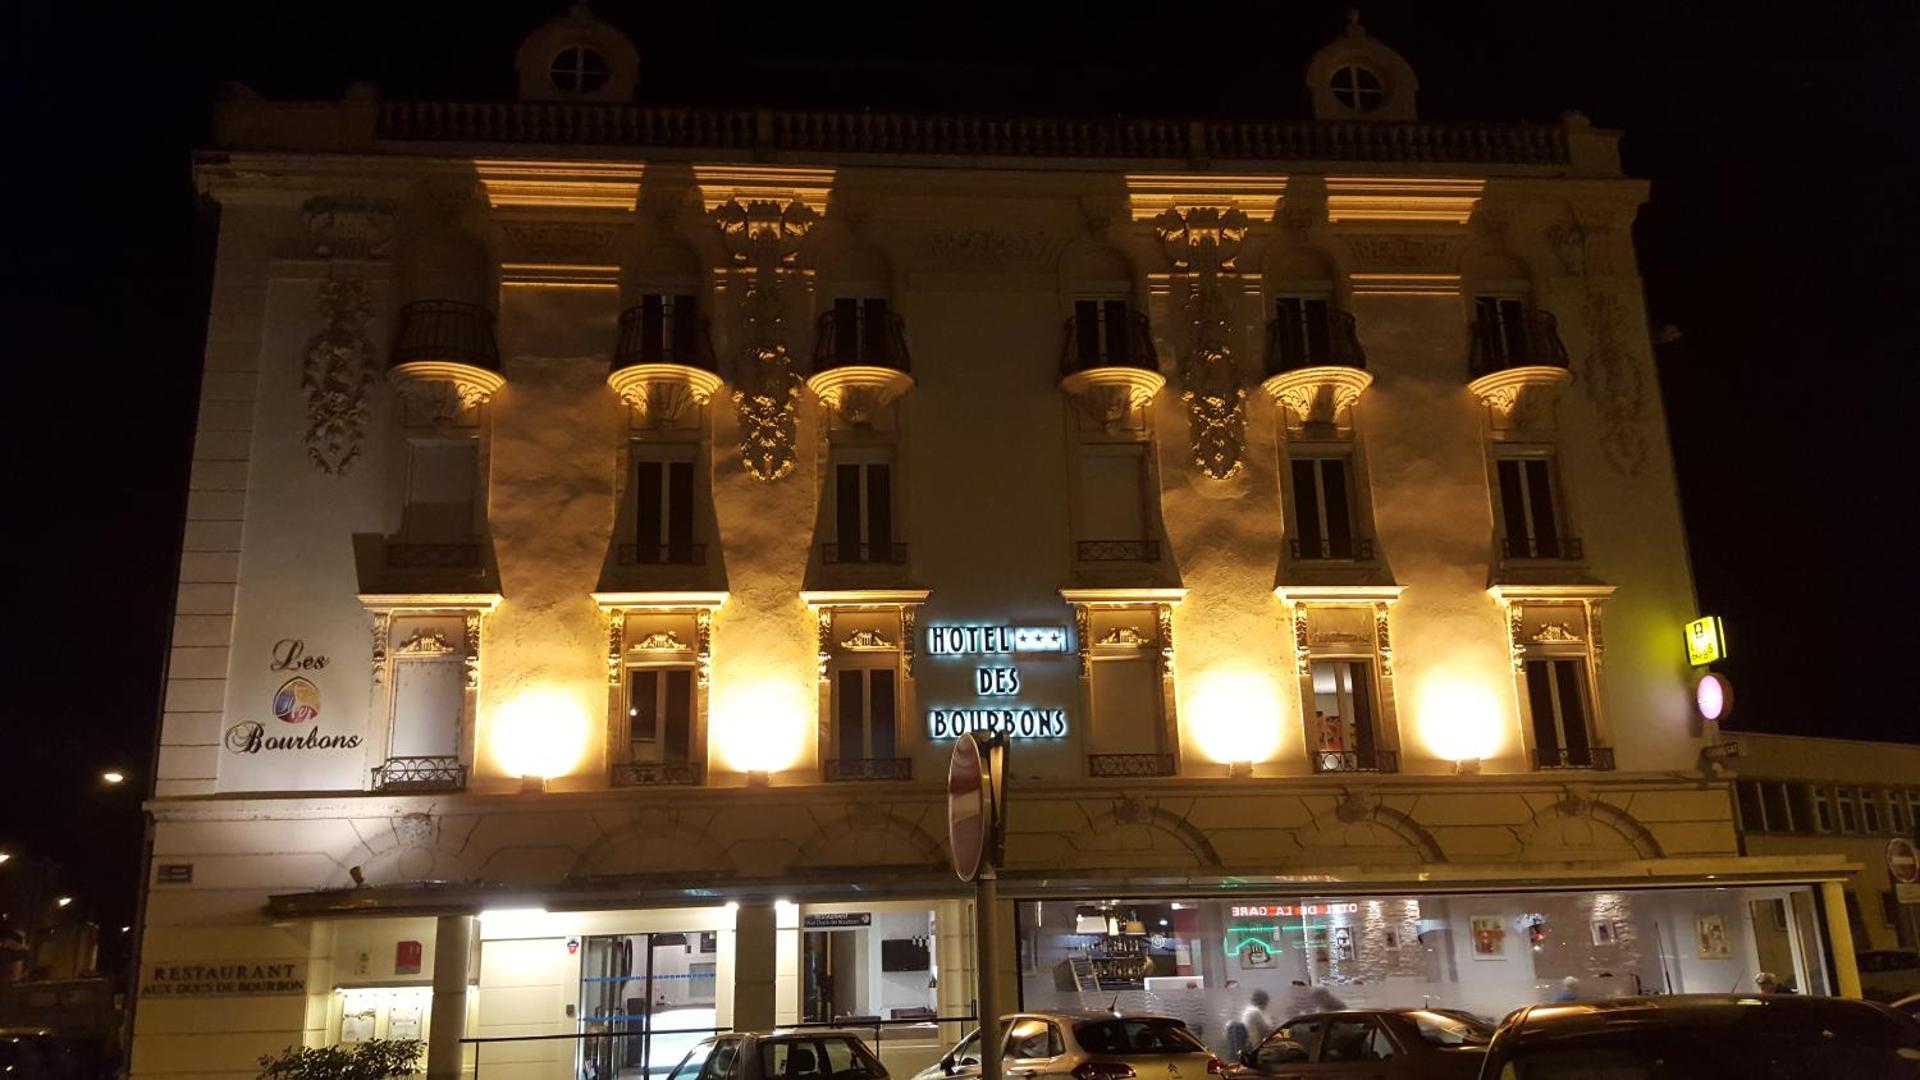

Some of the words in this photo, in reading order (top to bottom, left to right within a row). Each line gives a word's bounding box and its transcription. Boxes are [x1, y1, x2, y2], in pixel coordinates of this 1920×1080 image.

[931, 627, 1009, 651] HOTEL
[270, 639, 329, 671] Les
[979, 668, 1018, 692] DES
[933, 710, 1065, 736] BOURBONS
[225, 721, 363, 753] Bourbons
[154, 964, 295, 981] RESTAURANT
[238, 980, 304, 992] BOURBON
